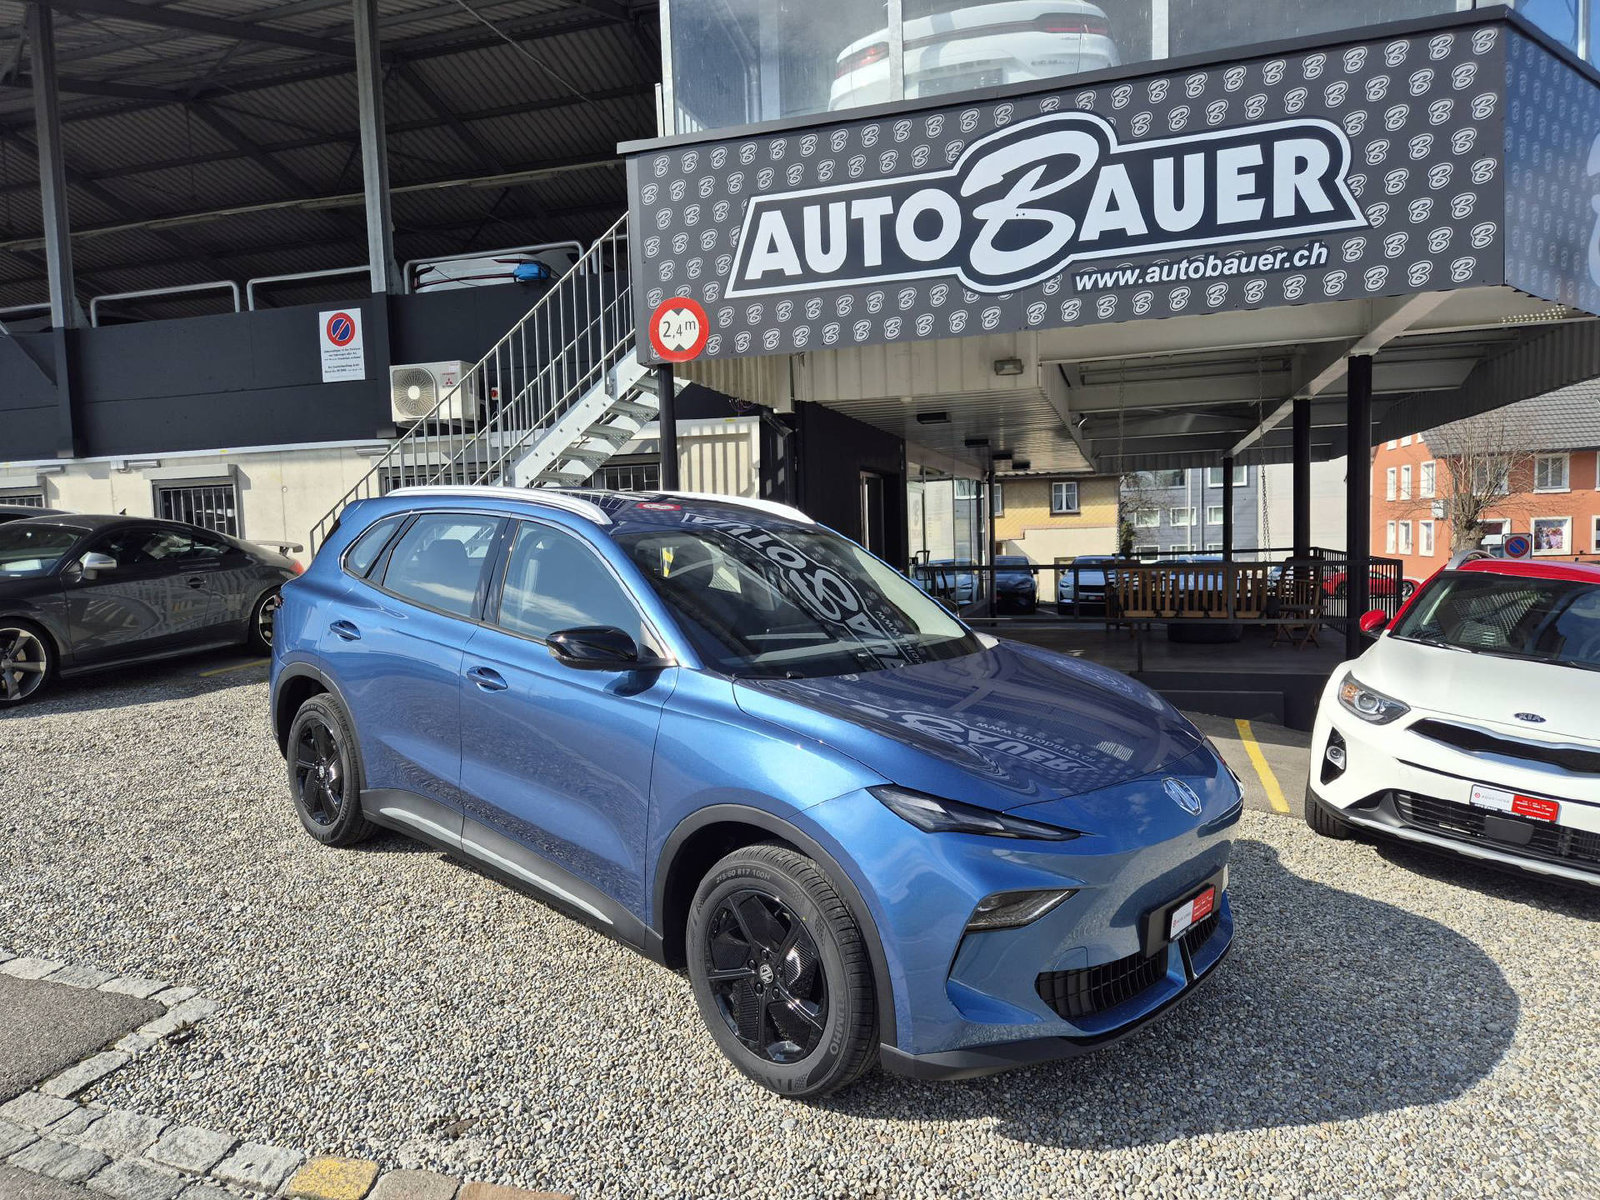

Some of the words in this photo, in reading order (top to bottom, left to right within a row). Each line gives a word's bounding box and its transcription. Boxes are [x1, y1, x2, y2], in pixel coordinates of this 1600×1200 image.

[1430, 35, 1453, 59] B
[1472, 29, 1497, 54] B
[1344, 48, 1367, 72] B
[1385, 41, 1409, 66] B
[1263, 61, 1285, 85] B
[1303, 54, 1325, 79] B
[1452, 63, 1477, 89] B
[1186, 74, 1207, 97] B
[1224, 67, 1245, 91] B
[1366, 76, 1389, 101] B
[1410, 69, 1433, 95] B
[1112, 85, 1132, 108] B
[1148, 80, 1169, 103] B
[1285, 88, 1307, 113] B
[1325, 82, 1347, 107] B
[995, 104, 1012, 127] B
[1207, 100, 1227, 124] B
[1245, 94, 1267, 119] B
[1429, 100, 1453, 124] B
[1472, 93, 1496, 119] B
[926, 115, 943, 137] B
[961, 109, 979, 132] B
[1132, 112, 1152, 136] B
[1169, 106, 1189, 130] B
[1345, 111, 1367, 136] B
[1385, 105, 1408, 130] B
[831, 130, 847, 151] B
[862, 125, 879, 146] B
[894, 121, 911, 141] B
[1452, 128, 1476, 154] B
[741, 143, 756, 164] B
[770, 139, 786, 159] B
[800, 135, 817, 156] B
[912, 146, 929, 167] B
[1366, 140, 1389, 164] B
[1409, 134, 1433, 159] B
[654, 156, 669, 176] B
[682, 152, 697, 172] B
[711, 148, 727, 168] B
[849, 155, 865, 177] B
[880, 151, 897, 172] B
[758, 168, 773, 189] B
[787, 164, 803, 185] B
[818, 160, 834, 180] B
[1429, 163, 1452, 188] B
[1472, 159, 1496, 183] B
[671, 181, 685, 200] B
[699, 177, 714, 197] B
[728, 172, 743, 193] B
[1385, 169, 1408, 194] B
[642, 183, 658, 204] B
[685, 205, 699, 225] B
[714, 201, 729, 221] B
[744, 188, 962, 281] AUTO
[960, 130, 1338, 274] BAUER
[1367, 203, 1388, 227] B
[1409, 198, 1432, 222] B
[1452, 193, 1476, 218] B
[657, 209, 671, 229] B
[673, 233, 688, 253] B
[701, 230, 717, 250] B
[1385, 233, 1408, 257] B
[1428, 228, 1452, 252] B
[1471, 223, 1495, 248] B
[645, 237, 659, 257] B
[1343, 238, 1366, 261] B
[660, 261, 674, 280] B
[687, 258, 702, 278] B
[716, 254, 732, 275] B
[1075, 242, 1329, 291] www.autobauer.ch
[1409, 261, 1432, 286] B
[1451, 258, 1475, 281] B
[1284, 275, 1306, 298] B
[1324, 271, 1346, 295] B
[1365, 266, 1388, 290] B
[647, 289, 664, 308] B
[704, 282, 718, 302] B
[867, 292, 883, 312] B
[899, 288, 916, 309] B
[930, 285, 948, 306] B
[1133, 291, 1153, 313] B
[1170, 287, 1190, 310] B
[1207, 283, 1227, 306] B
[1245, 280, 1266, 302] B
[747, 304, 762, 324] B
[777, 301, 792, 321] B
[806, 299, 822, 319] B
[837, 295, 853, 316] B
[1028, 303, 1046, 324] B
[1062, 299, 1081, 320] B
[1097, 295, 1117, 317] B
[719, 307, 733, 327] B
[885, 318, 901, 338] B
[917, 314, 933, 335] B
[950, 311, 967, 332] B
[982, 307, 1000, 329] B
[764, 329, 779, 349] B
[794, 326, 809, 346] B
[823, 323, 839, 343] B
[854, 321, 870, 340] B
[706, 335, 721, 354] B
[736, 332, 750, 352] B
[1518, 712, 1542, 722] KIA
